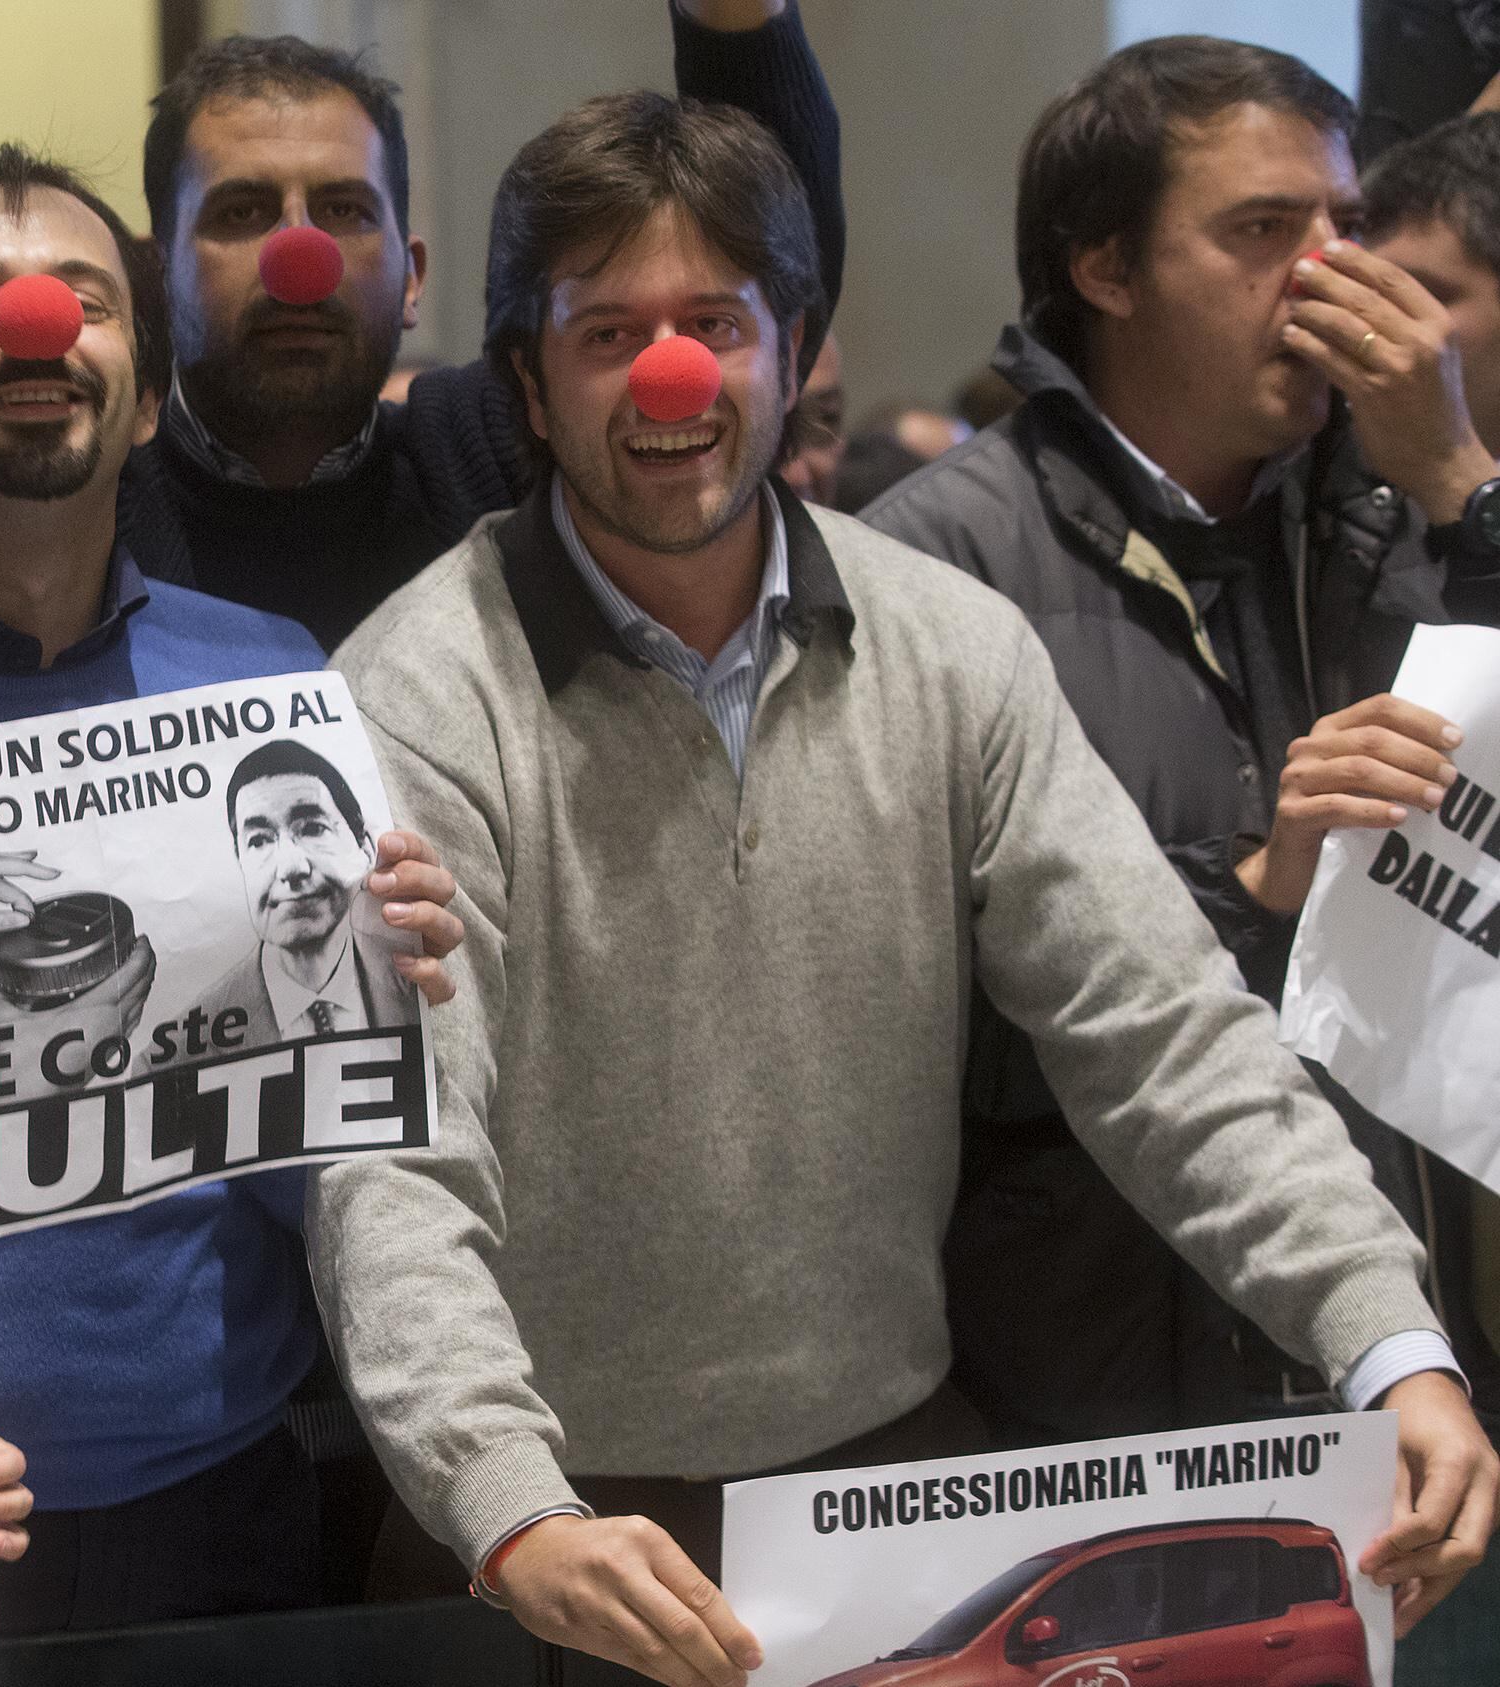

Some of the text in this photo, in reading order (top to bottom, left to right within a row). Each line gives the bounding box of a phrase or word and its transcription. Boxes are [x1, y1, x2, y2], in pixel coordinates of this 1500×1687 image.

[58, 697, 276, 769] SOLDINO
[288, 689, 342, 729] AL
[35, 762, 213, 828] MARINO
[813, 1431, 1342, 1535] CONCESSIONARIA "MARINO"
